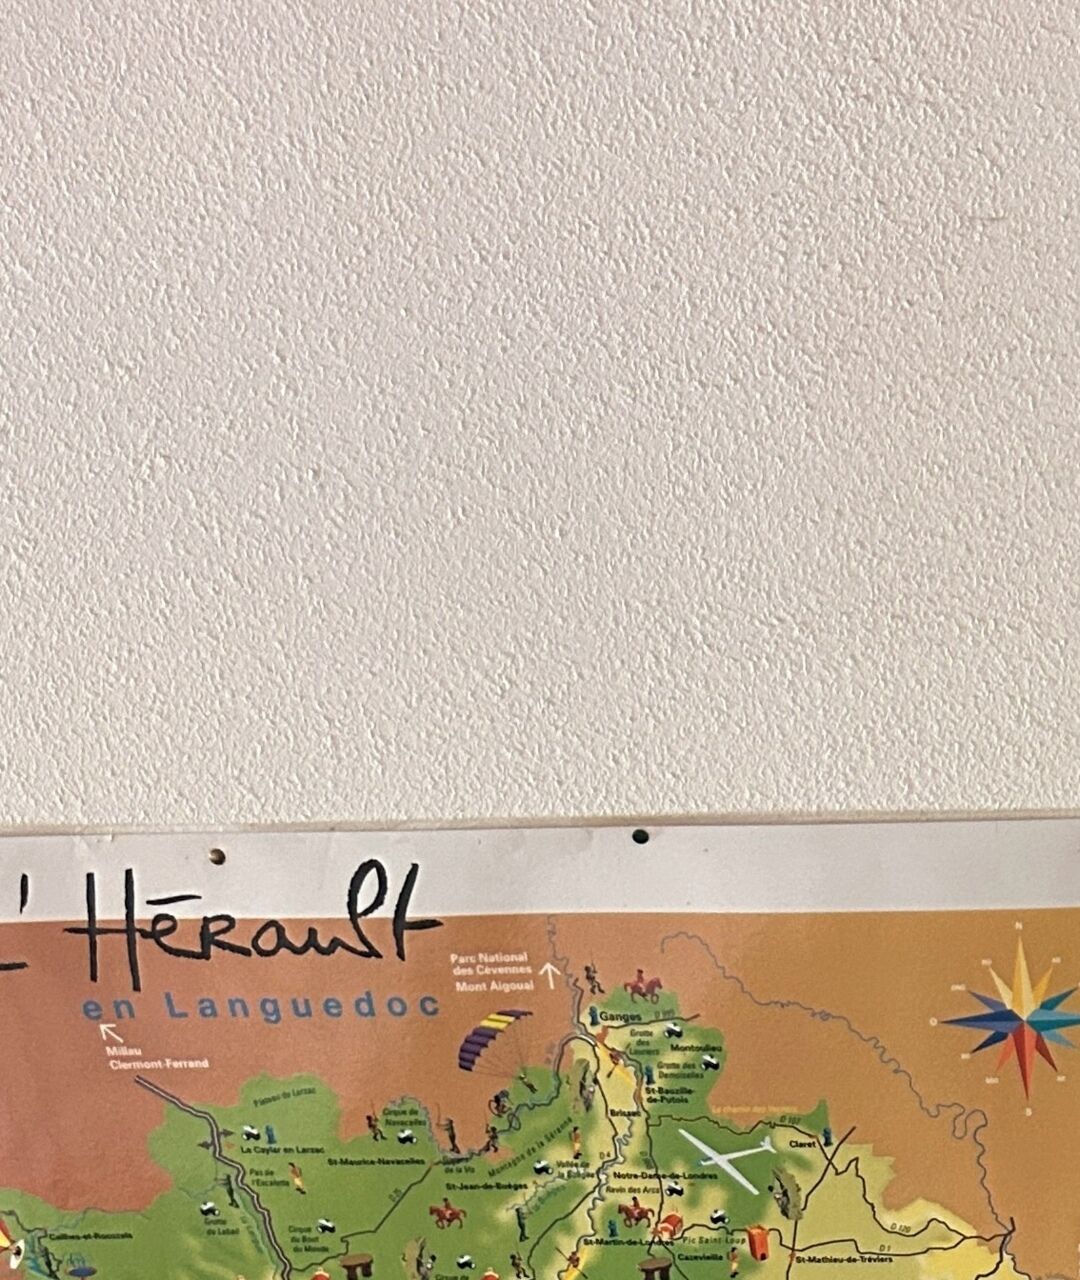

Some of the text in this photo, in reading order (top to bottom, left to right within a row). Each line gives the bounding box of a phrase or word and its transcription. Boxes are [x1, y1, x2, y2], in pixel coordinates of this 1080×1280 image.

[451, 952, 528, 964] Parc National
[453, 964, 532, 976] des Cévennes
[455, 979, 534, 993] Mont Aigoual
[82, 990, 441, 1024] en Languedoc
[600, 1011, 642, 1024] Ganges
[106, 1045, 143, 1057] Millau
[109, 1057, 210, 1071] Clermont-Ferrand
[789, 1139, 817, 1149] Claret
